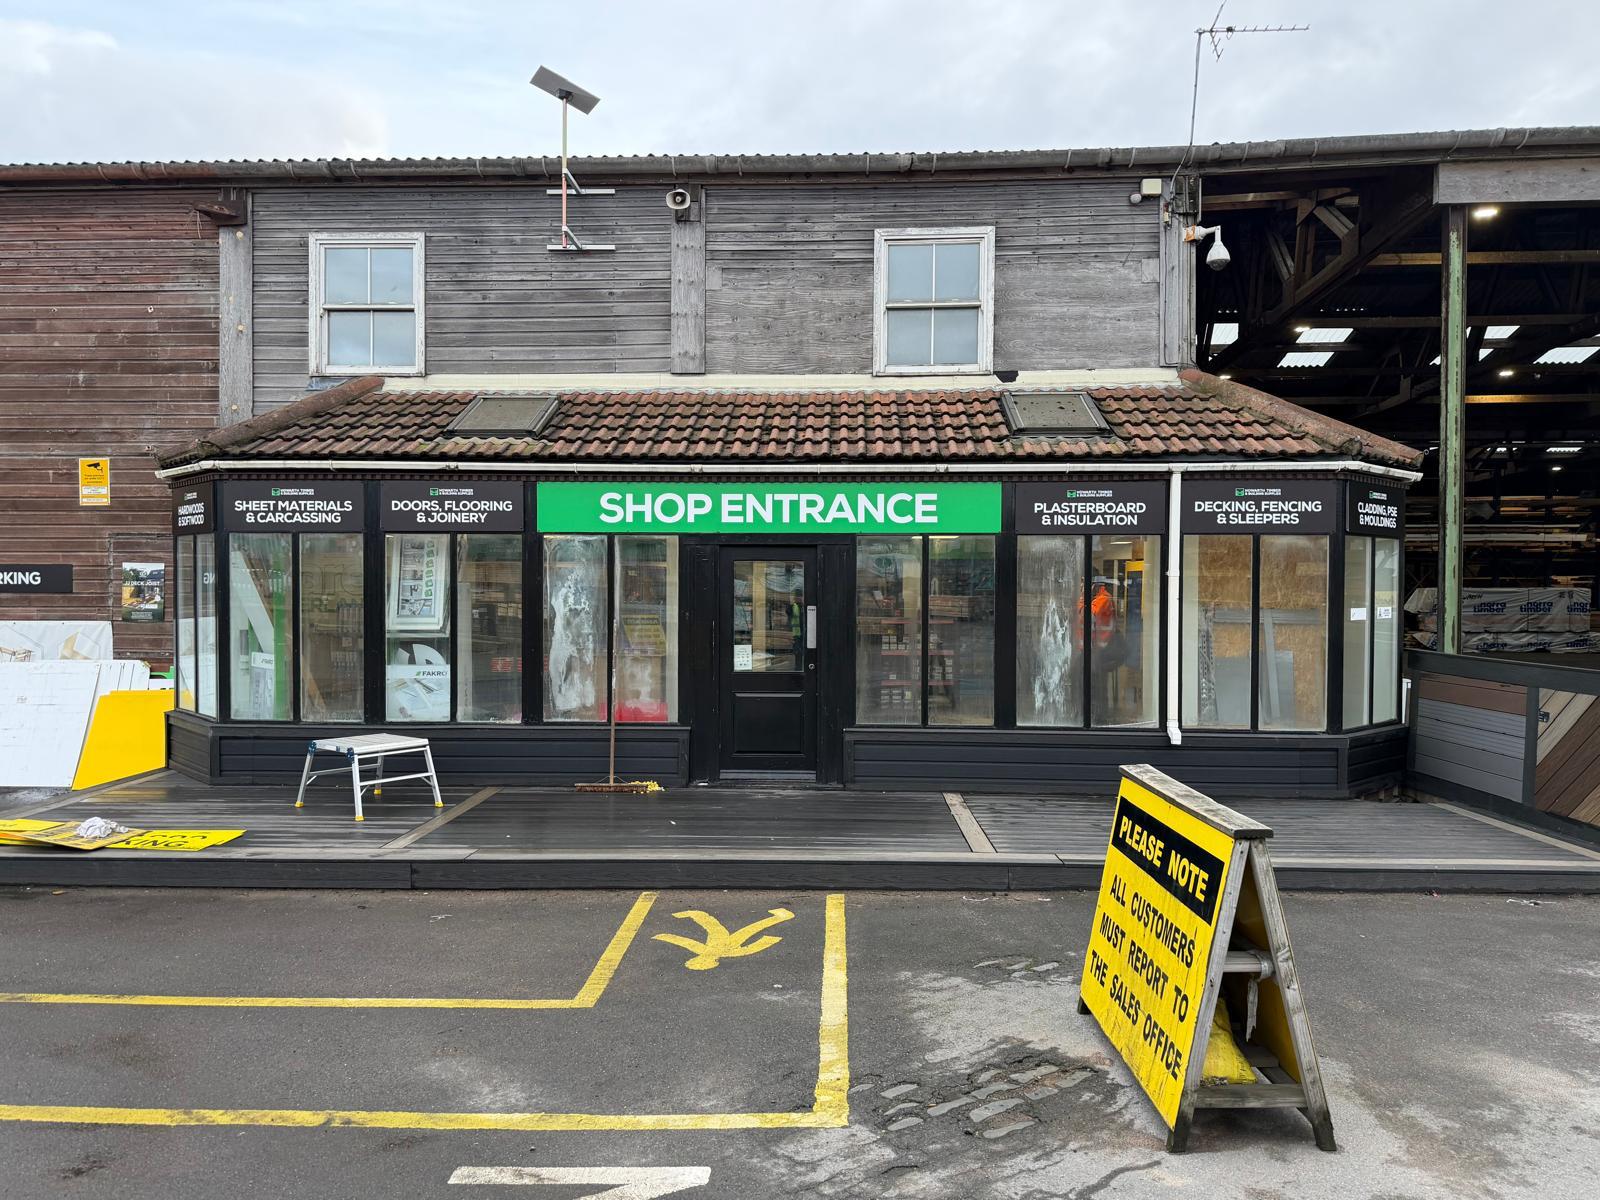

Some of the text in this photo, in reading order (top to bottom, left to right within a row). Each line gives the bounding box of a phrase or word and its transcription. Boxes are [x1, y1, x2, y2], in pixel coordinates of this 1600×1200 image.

[178, 502, 205, 516] HARDWOODS
[234, 500, 353, 511] SHEET MATERIALS
[391, 500, 513, 512] DOORS, FLOORING
[599, 492, 938, 524] SHOP ENTRANCE
[1034, 502, 1147, 514] PLASTERBOARD
[1194, 501, 1322, 513] DECKING, FENCING
[1387, 505, 1398, 517] PSE
[181, 514, 205, 527] SOFTWOOD
[245, 512, 342, 523] & CARCASSING
[416, 512, 488, 523] & JOINERY
[1041, 514, 1138, 526] & INSULATION
[1216, 513, 1300, 524] & SLEEPERS
[1359, 514, 1397, 529] & MOULDINGS
[1473, 604, 1505, 613] timber
[1520, 604, 1551, 613] timber
[1119, 815, 1209, 902] PLEASE NOTE
[1110, 874, 1195, 969] ALL CUSTOMERS
[1100, 911, 1189, 1023] MUST REPORT TO
[1089, 949, 1183, 1081] THE SALES OFFICE
